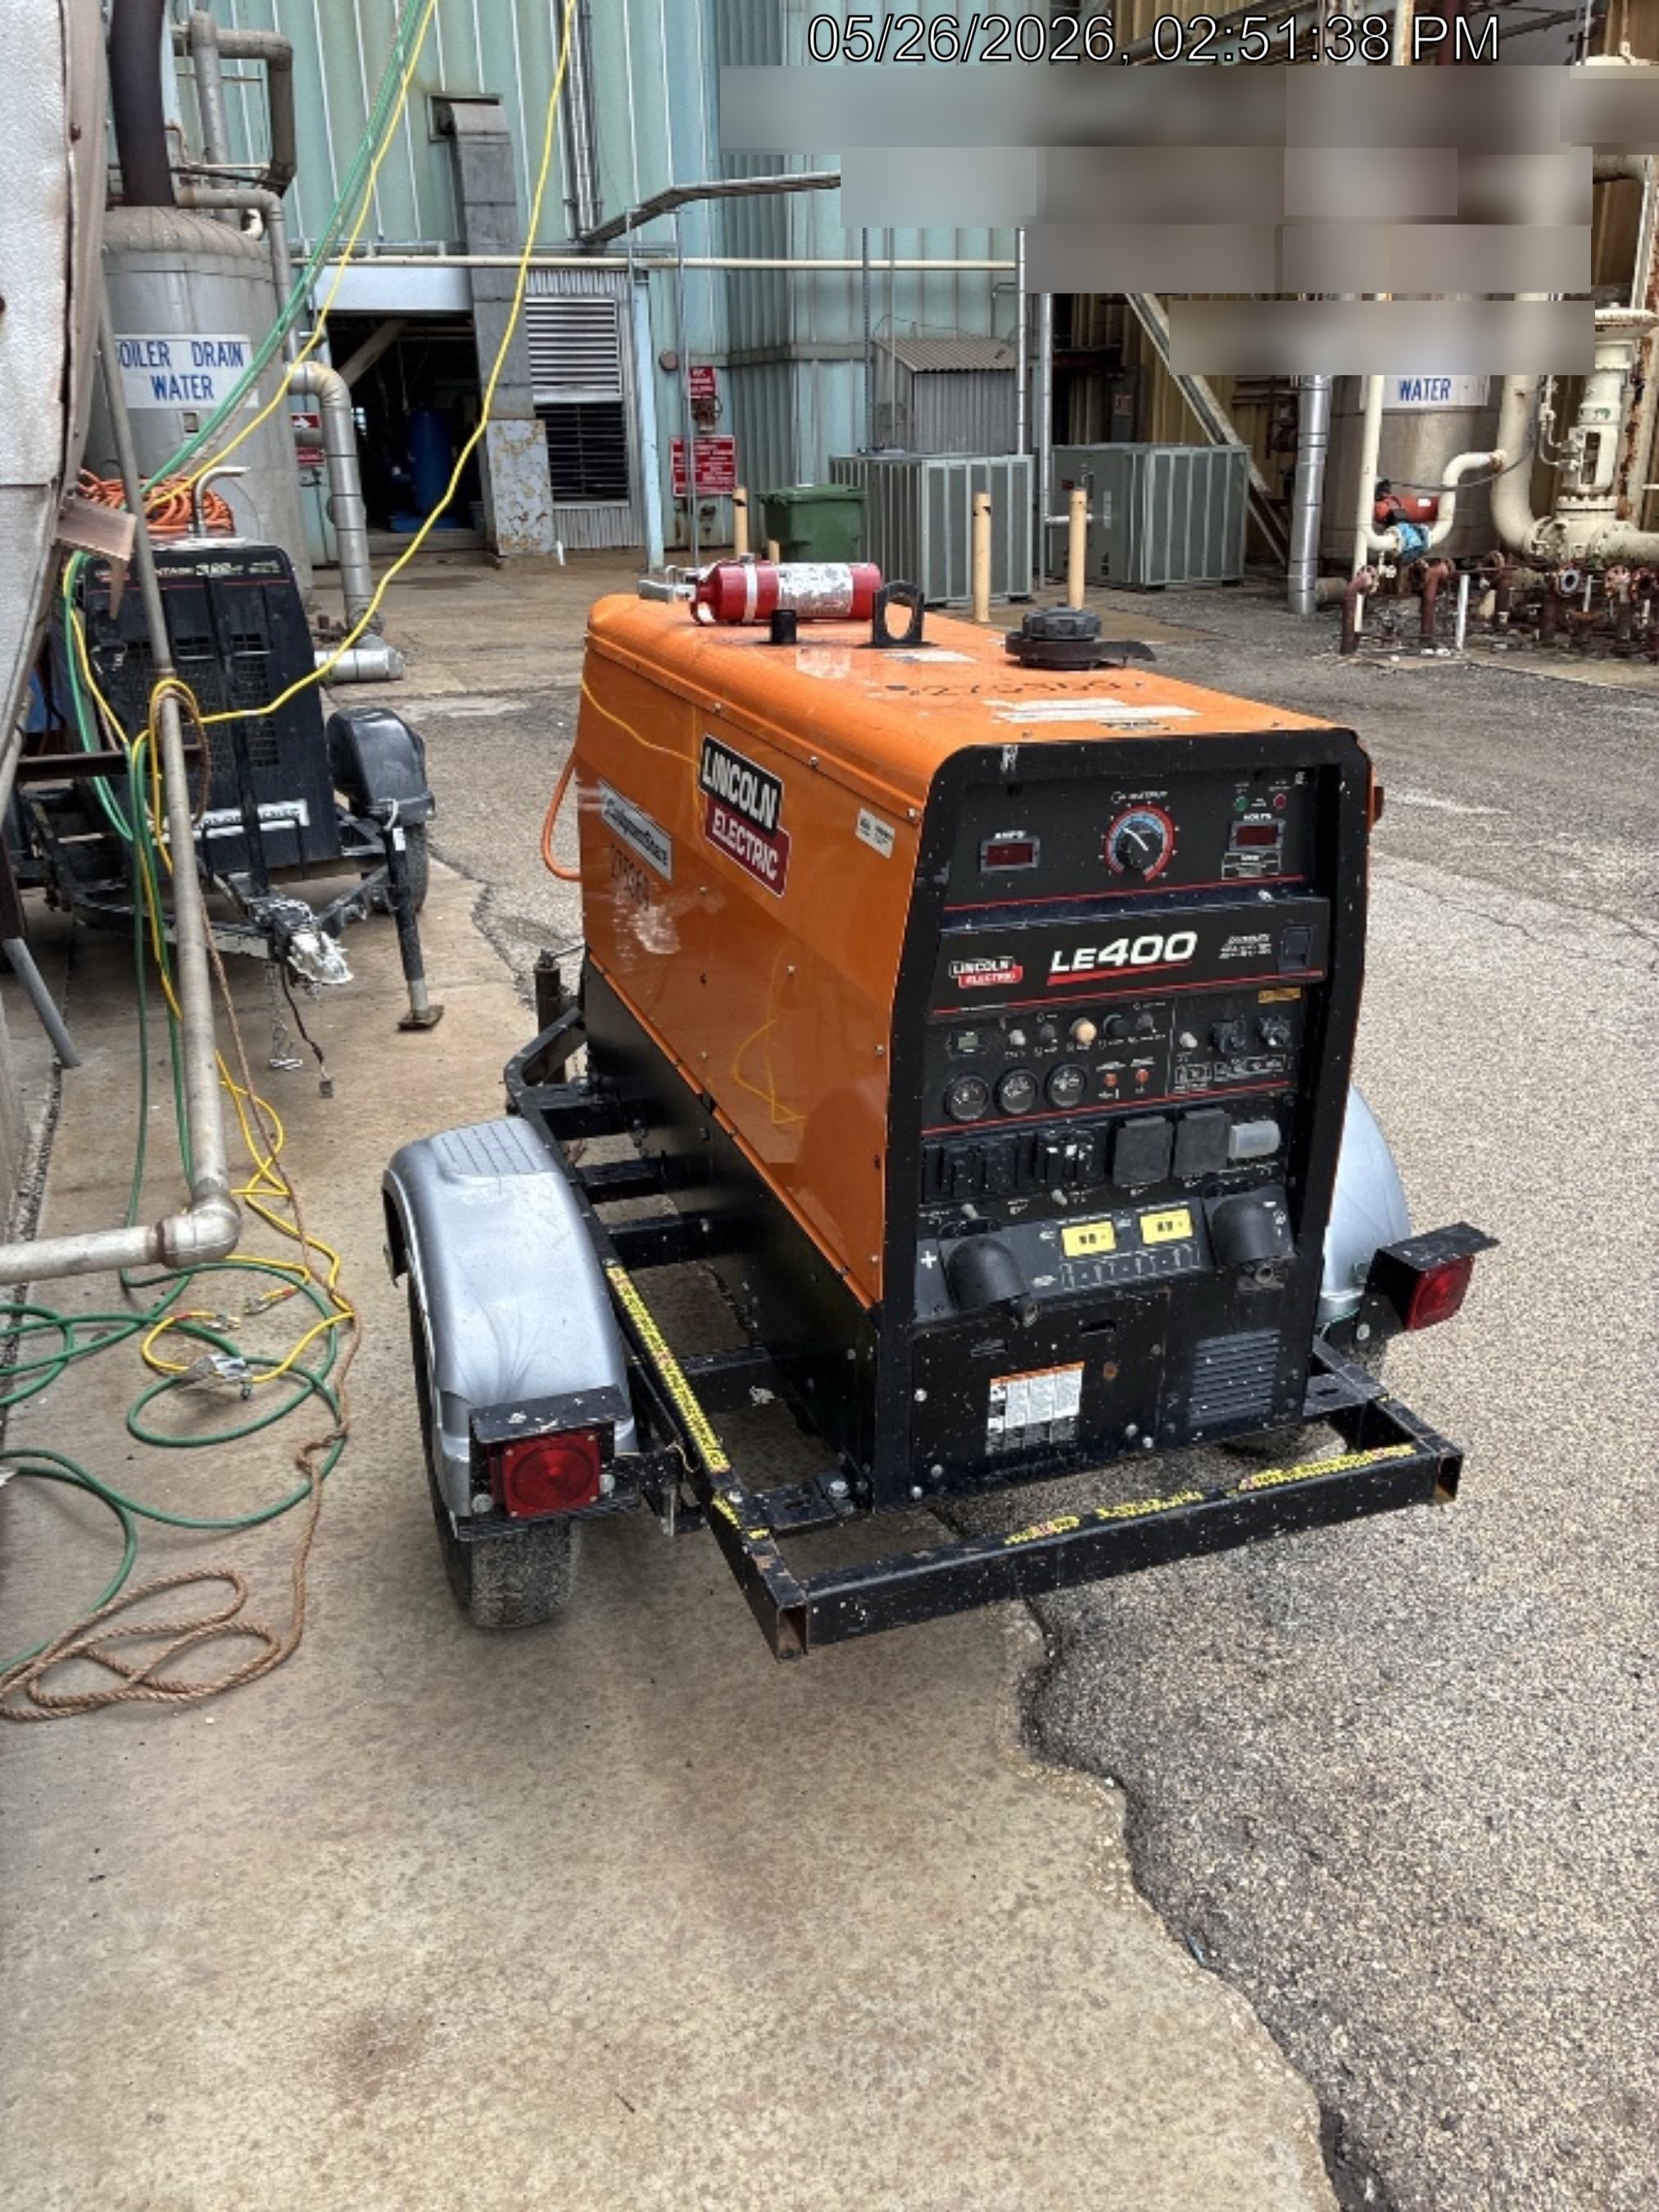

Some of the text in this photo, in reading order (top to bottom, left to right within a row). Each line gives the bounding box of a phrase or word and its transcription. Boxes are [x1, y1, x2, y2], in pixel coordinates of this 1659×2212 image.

[118, 339, 244, 369] OILER DRAIN
[150, 374, 215, 401] WATER
[1398, 378, 1452, 402] WATER
[701, 746, 777, 830] LINCOLN
[712, 808, 778, 882] ELECTRIC
[1049, 930, 1199, 973] LE400
[953, 959, 1011, 976] LINCOLN
